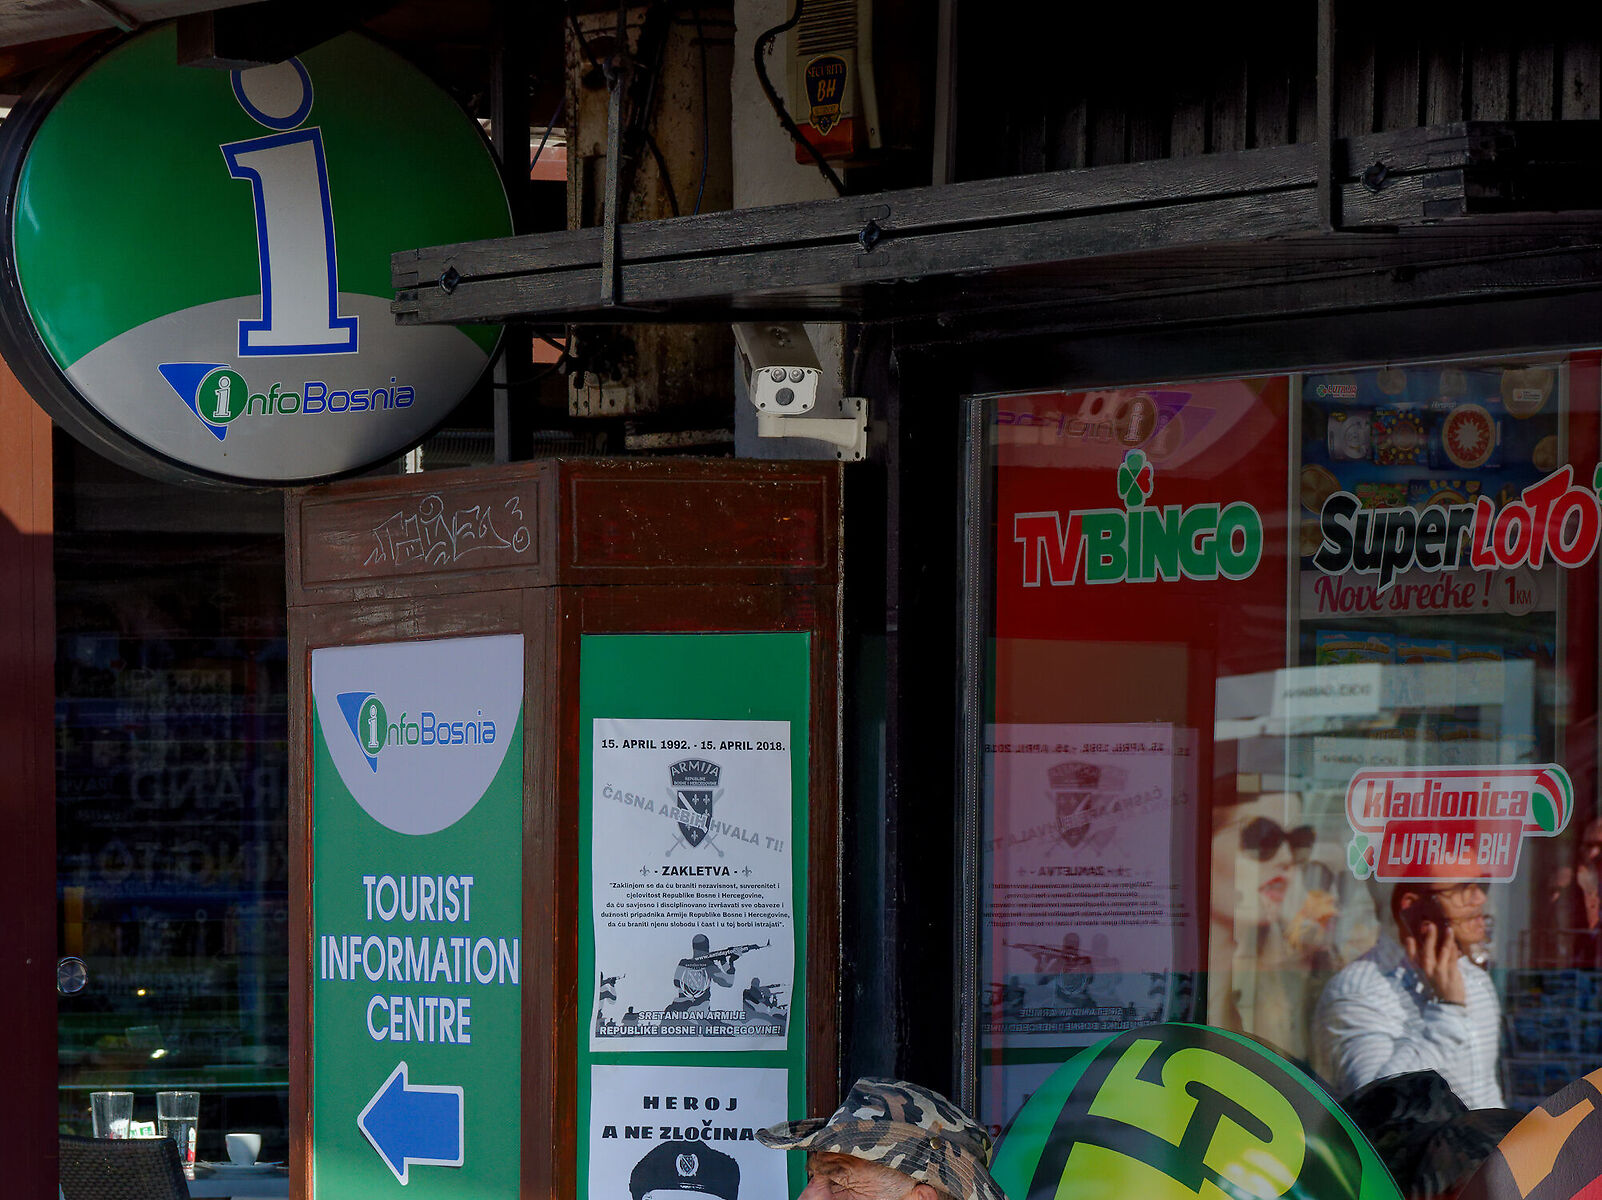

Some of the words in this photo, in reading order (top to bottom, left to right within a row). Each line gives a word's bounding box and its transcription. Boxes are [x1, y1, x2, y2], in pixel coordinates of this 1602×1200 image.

[817, 79, 838, 102] BH
[601, 739, 619, 749] 15.
[622, 739, 657, 749] APRIL
[660, 740, 691, 750] 1992.
[701, 741, 716, 750] 15.
[719, 741, 753, 751] APRIL
[756, 741, 786, 751] 2018.
[671, 761, 719, 777] ARMIJA
[1363, 779, 1529, 818] kladionica
[602, 783, 655, 812] ČASNA
[710, 818, 760, 846] HVALA
[765, 836, 785, 853] TI!
[1387, 832, 1474, 866] LUTRIJE
[1476, 832, 1511, 865] BIH
[662, 866, 730, 876] ZAKLETVA
[362, 875, 474, 922] TOURIST
[320, 934, 520, 985] INFORMATION
[366, 993, 471, 1044] CENTRE
[638, 1011, 679, 1020] SRETAN
[682, 1011, 704, 1020] DAN
[706, 1011, 746, 1020] ARMIJE
[600, 1025, 658, 1035] REPUBLIKE
[661, 1026, 696, 1035] BOSNE
[705, 1025, 781, 1036] HERCEGOVINE!
[643, 1096, 738, 1111] HEROJ
[602, 1125, 618, 1139] A
[624, 1126, 653, 1139] NE
[659, 1119, 765, 1140] ZLOČINA
